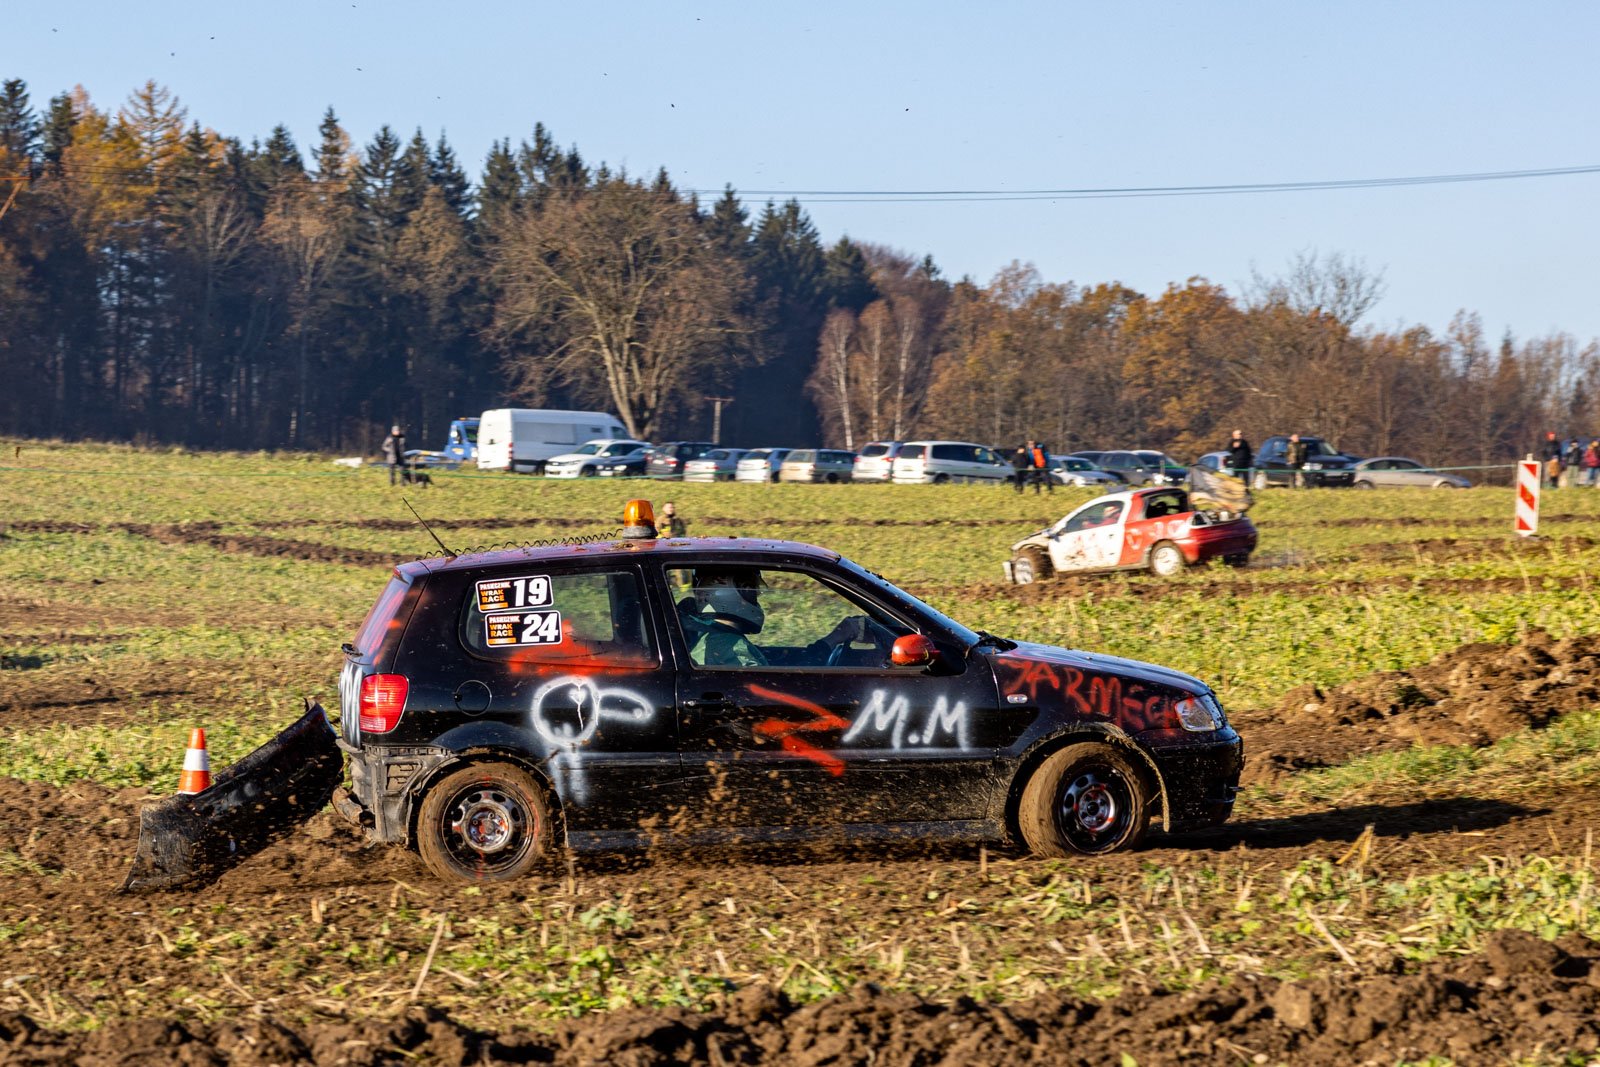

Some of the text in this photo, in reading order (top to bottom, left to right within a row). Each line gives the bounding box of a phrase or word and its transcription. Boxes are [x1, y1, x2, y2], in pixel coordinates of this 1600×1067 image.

[480, 589, 504, 597] WRAK
[514, 578, 548, 607] 19
[482, 595, 505, 603] RACE
[489, 623, 513, 631] WRAK
[521, 613, 559, 643] 24
[490, 629, 514, 637] RACE
